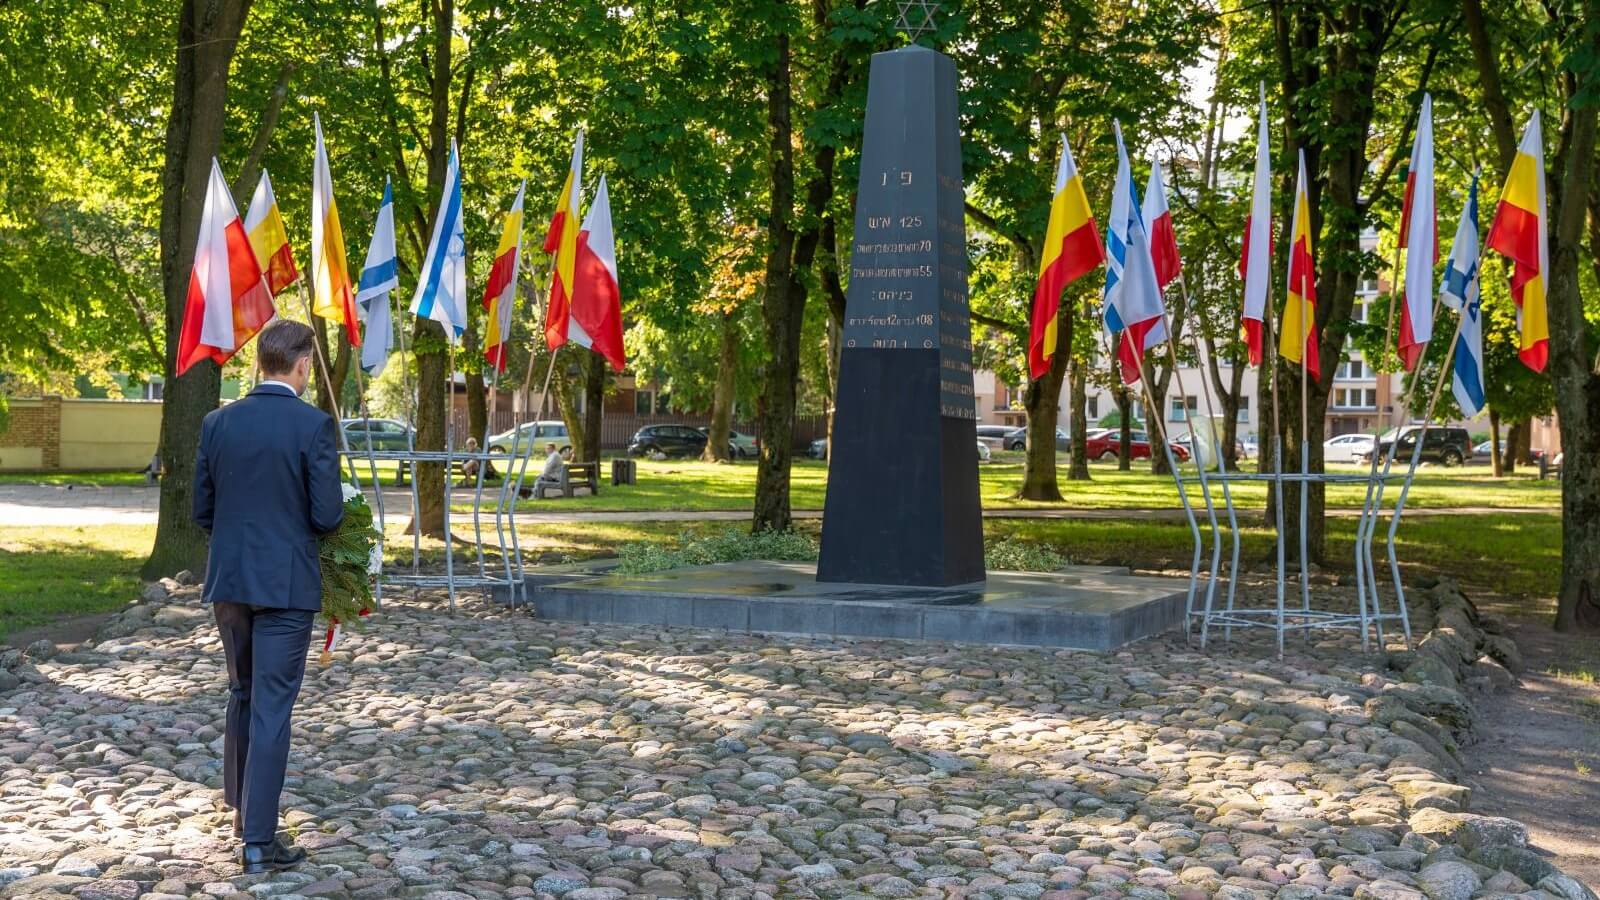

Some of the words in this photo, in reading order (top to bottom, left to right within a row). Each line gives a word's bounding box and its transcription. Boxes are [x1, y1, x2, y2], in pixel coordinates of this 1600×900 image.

[899, 216, 922, 228] 125
[919, 240, 932, 252] 70
[920, 265, 933, 277] 55
[886, 314, 897, 326] 12
[916, 314, 933, 326] 108
